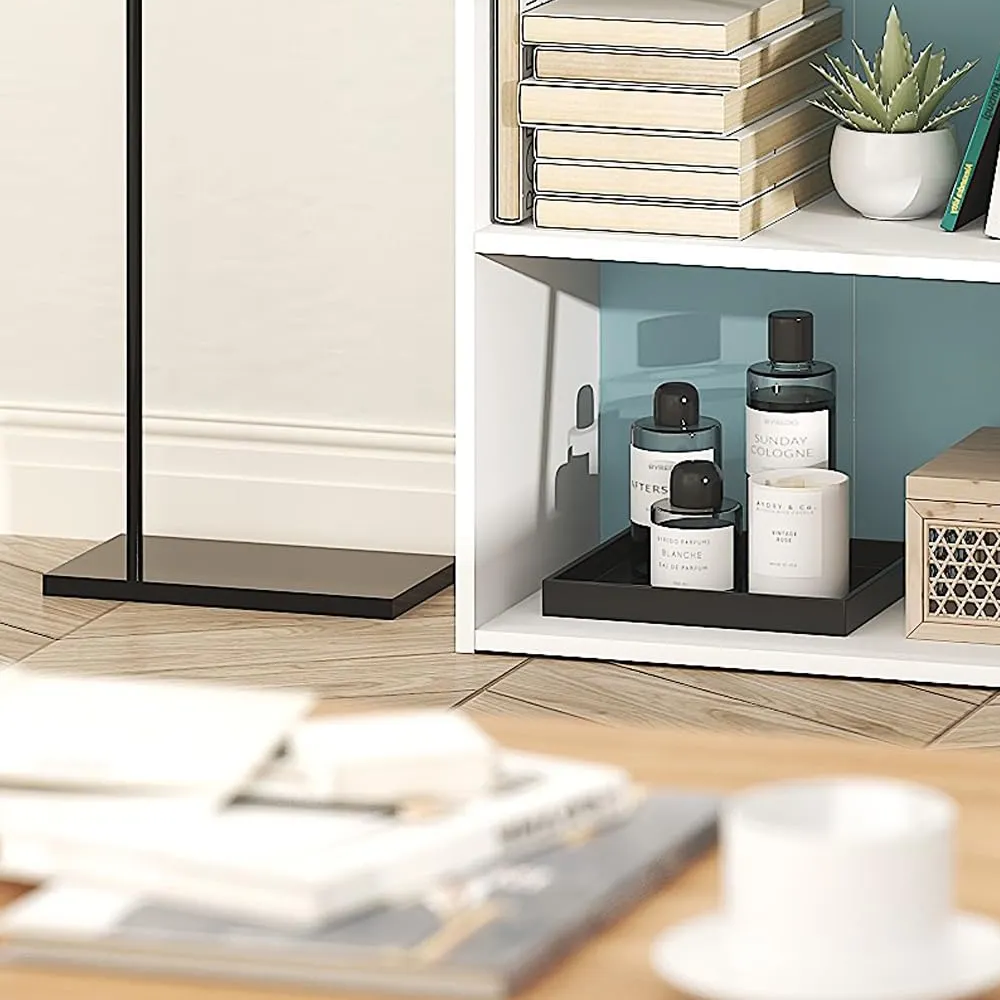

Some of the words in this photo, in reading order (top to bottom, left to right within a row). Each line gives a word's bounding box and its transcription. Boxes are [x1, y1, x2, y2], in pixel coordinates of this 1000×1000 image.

[754, 434, 808, 446] SUNDAY
[750, 445, 814, 458] COLOGNE
[661, 548, 702, 560] BLANCHE
